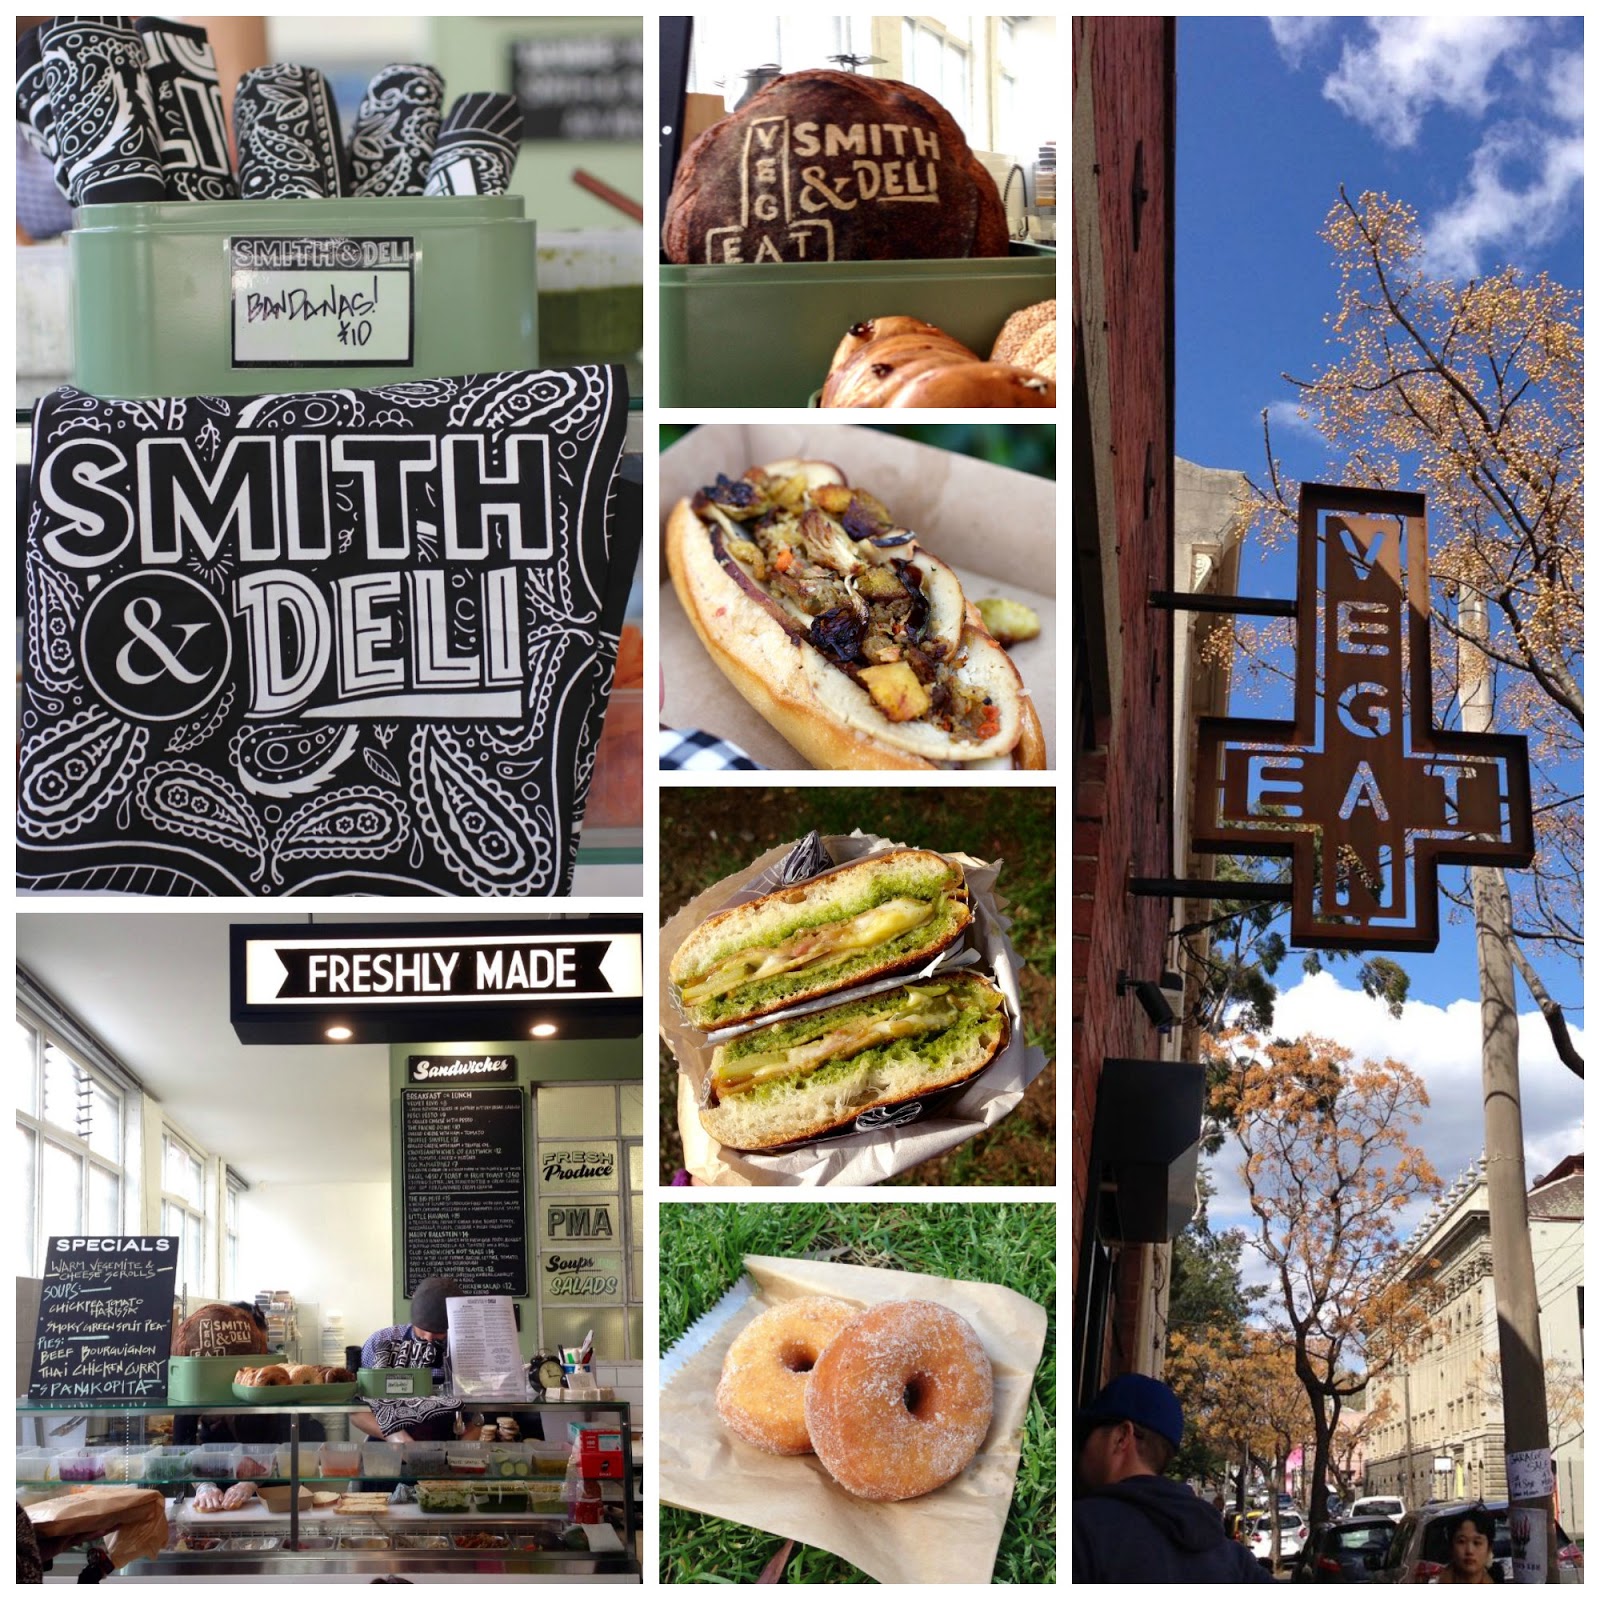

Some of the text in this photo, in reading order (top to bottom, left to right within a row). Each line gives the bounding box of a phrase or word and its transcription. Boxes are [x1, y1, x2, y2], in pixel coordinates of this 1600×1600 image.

[793, 122, 941, 160] SMITH
[799, 159, 938, 212] & DELI
[233, 240, 335, 267] SMITH
[362, 241, 410, 267] DELI
[723, 231, 813, 263] EAT
[247, 275, 379, 323] BANDANAS!
[39, 434, 554, 569] SMITH
[232, 567, 524, 718] DELI
[1335, 529, 1393, 909] VEGAN
[1247, 755, 1477, 826] EAT
[308, 948, 577, 994] FRESHLY MADE
[413, 1056, 509, 1081] Sandwiches
[406, 1092, 441, 1100] BREAKFAST
[451, 1091, 472, 1100] LUNCH
[543, 1151, 614, 1166] FRESH
[543, 1164, 613, 1182] Produce
[548, 1208, 613, 1237] PMA
[56, 1238, 170, 1252] SPECIALS
[51, 1259, 85, 1273] WARM
[145, 1260, 154, 1269] &
[545, 1255, 595, 1274] Soups
[60, 1269, 156, 1283] CHEESE SCROLLS
[550, 1275, 618, 1296] SALADS
[45, 1321, 83, 1334] SMOKY
[144, 1319, 167, 1333] PEA
[213, 1320, 251, 1331] SMITH
[216, 1331, 251, 1345] & DELI
[40, 1347, 74, 1365] BEEF
[124, 1360, 166, 1380] CURRY
